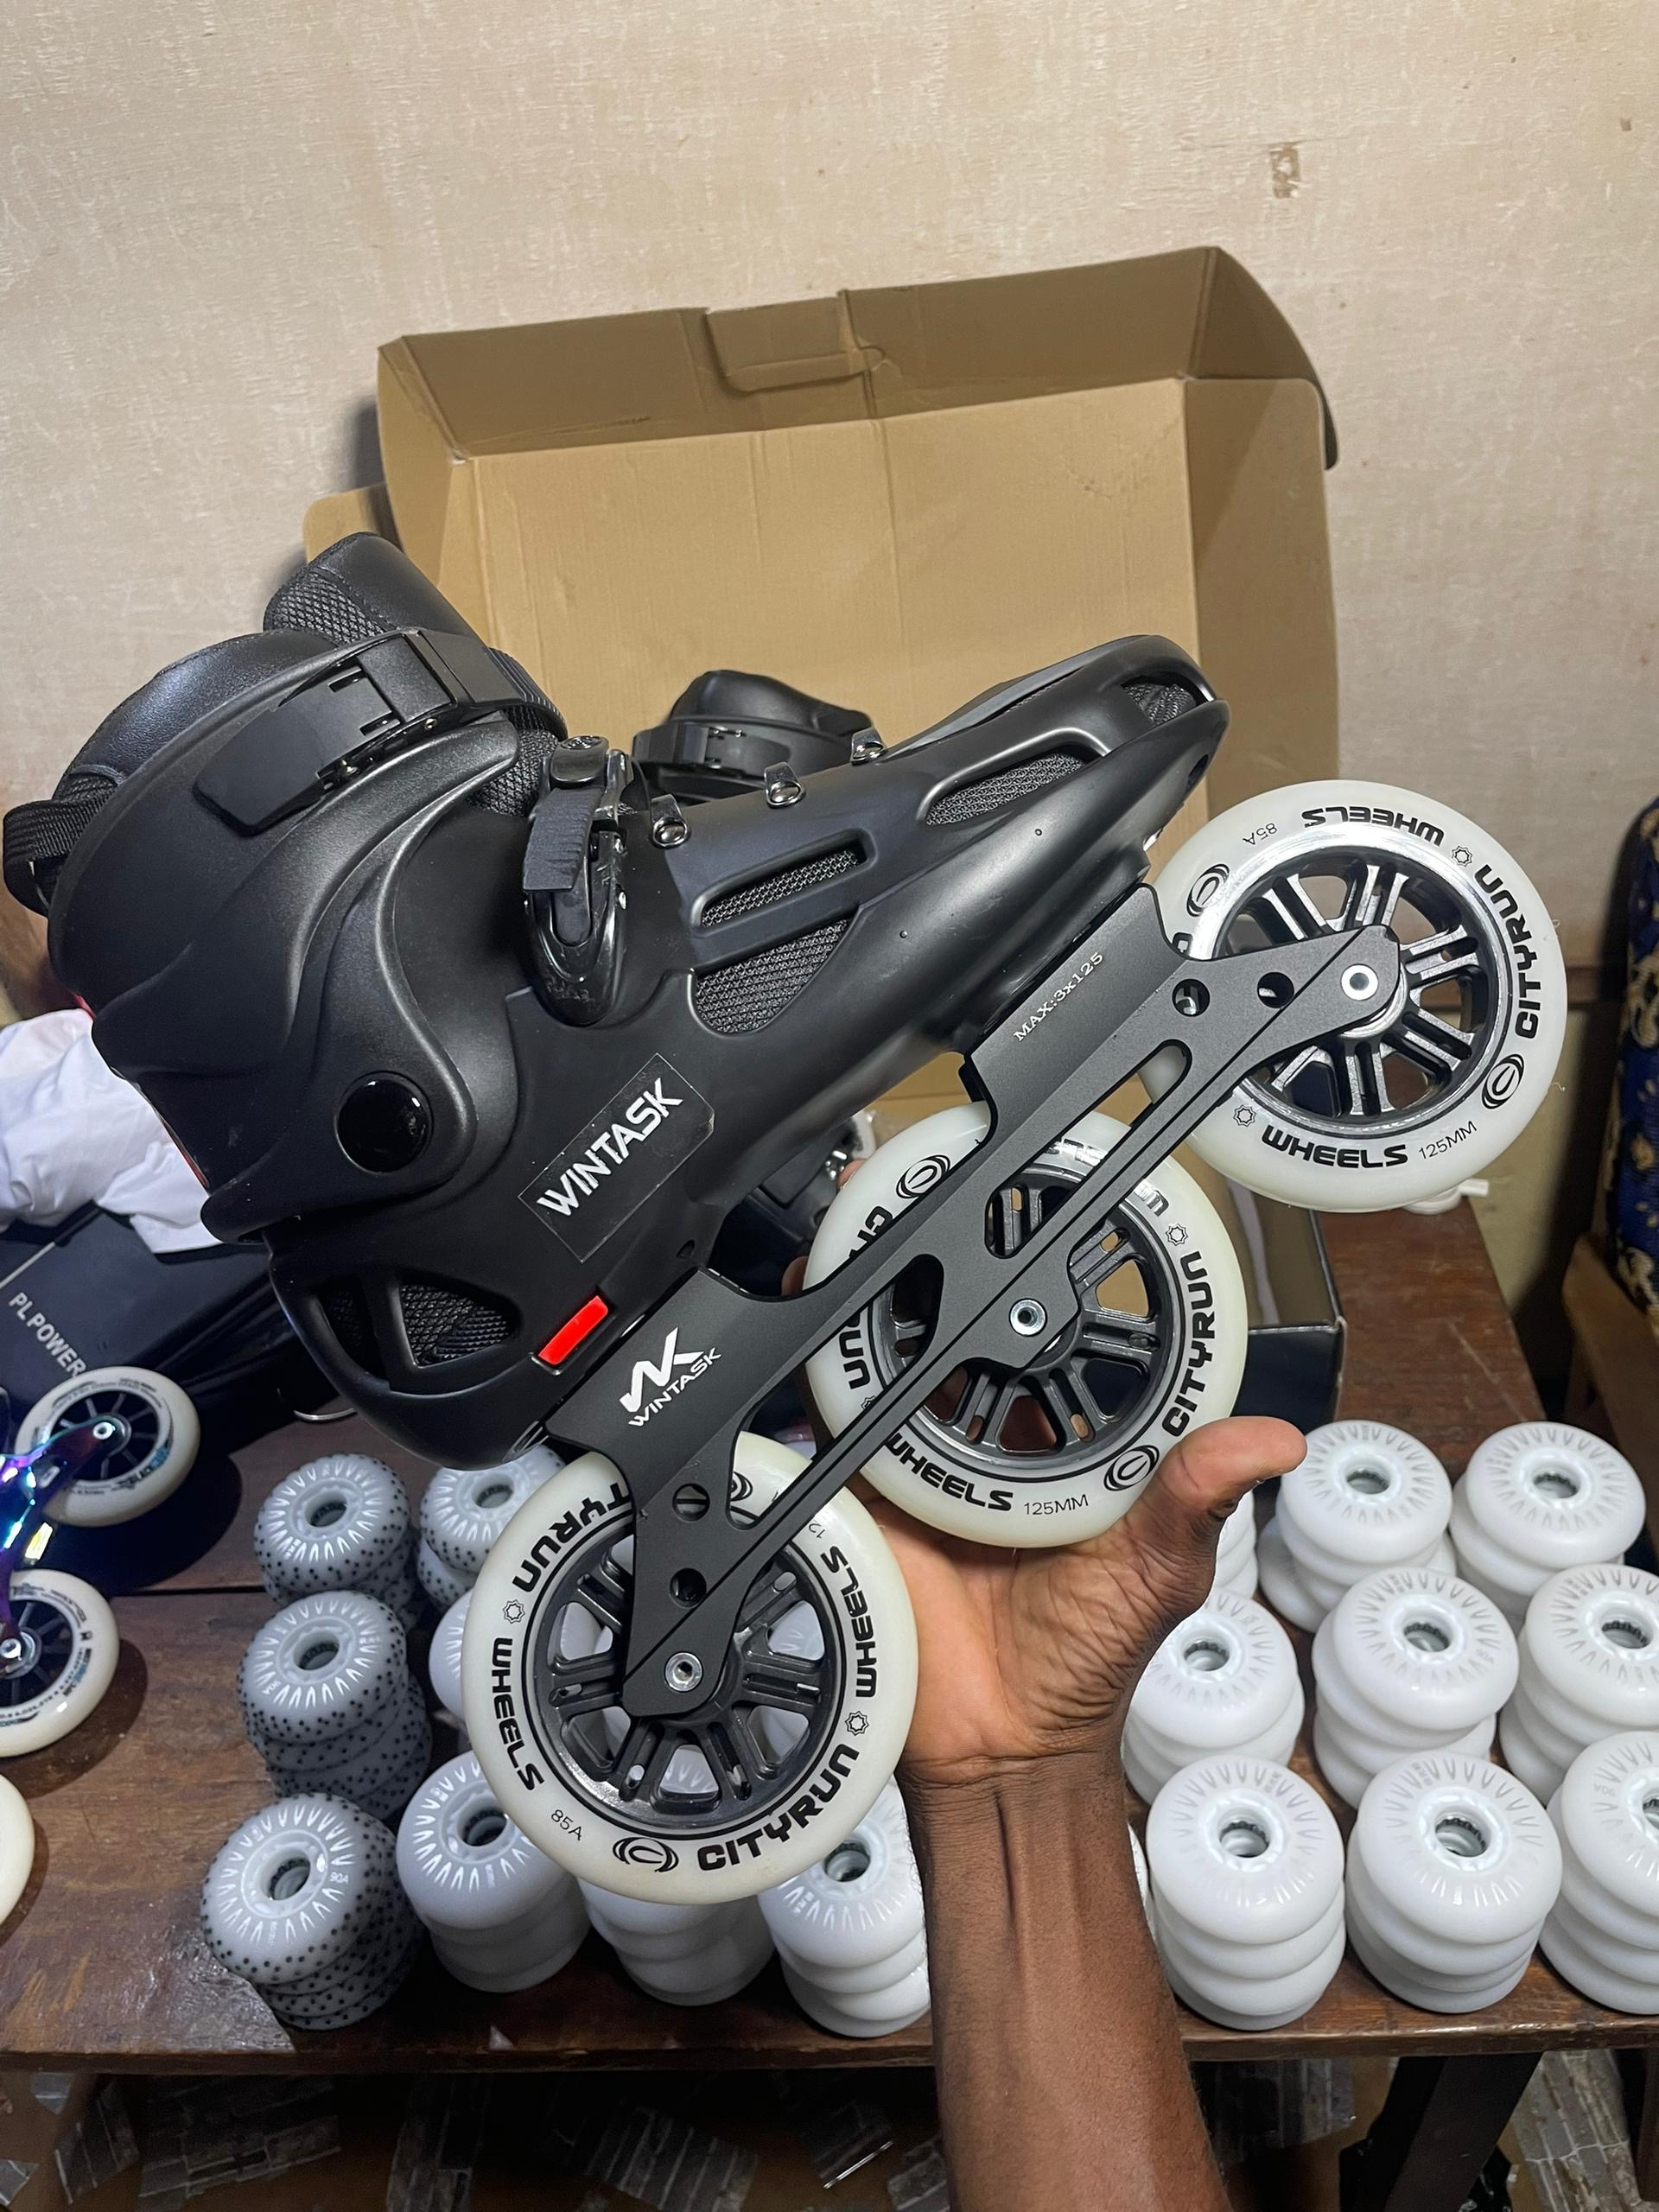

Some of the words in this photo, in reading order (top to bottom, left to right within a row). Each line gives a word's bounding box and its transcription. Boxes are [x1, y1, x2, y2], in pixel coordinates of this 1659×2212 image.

[1242, 823, 1278, 846] 85A
[1300, 805, 1445, 848] WHEELS
[1474, 864, 1541, 1039] CITYRUN
[1013, 951, 1104, 1042] MAX:3x125
[536, 1077, 683, 1217] WINTASK
[1261, 1124, 1408, 1169] WHEELS
[1418, 1120, 1478, 1160] 125MM
[8, 1292, 34, 1321] PL
[26, 1312, 87, 1377] POWER
[1161, 1250, 1216, 1437] CITYRUN
[627, 1347, 722, 1427] WINTASK
[512, 1482, 632, 1592] TYRUN
[1023, 1493, 1090, 1516] 125MM
[820, 1545, 878, 1698] WHEELS
[491, 1637, 545, 1791] WHEELS
[550, 1808, 583, 1841] 85A
[696, 1743, 861, 1872] CITYRUN
